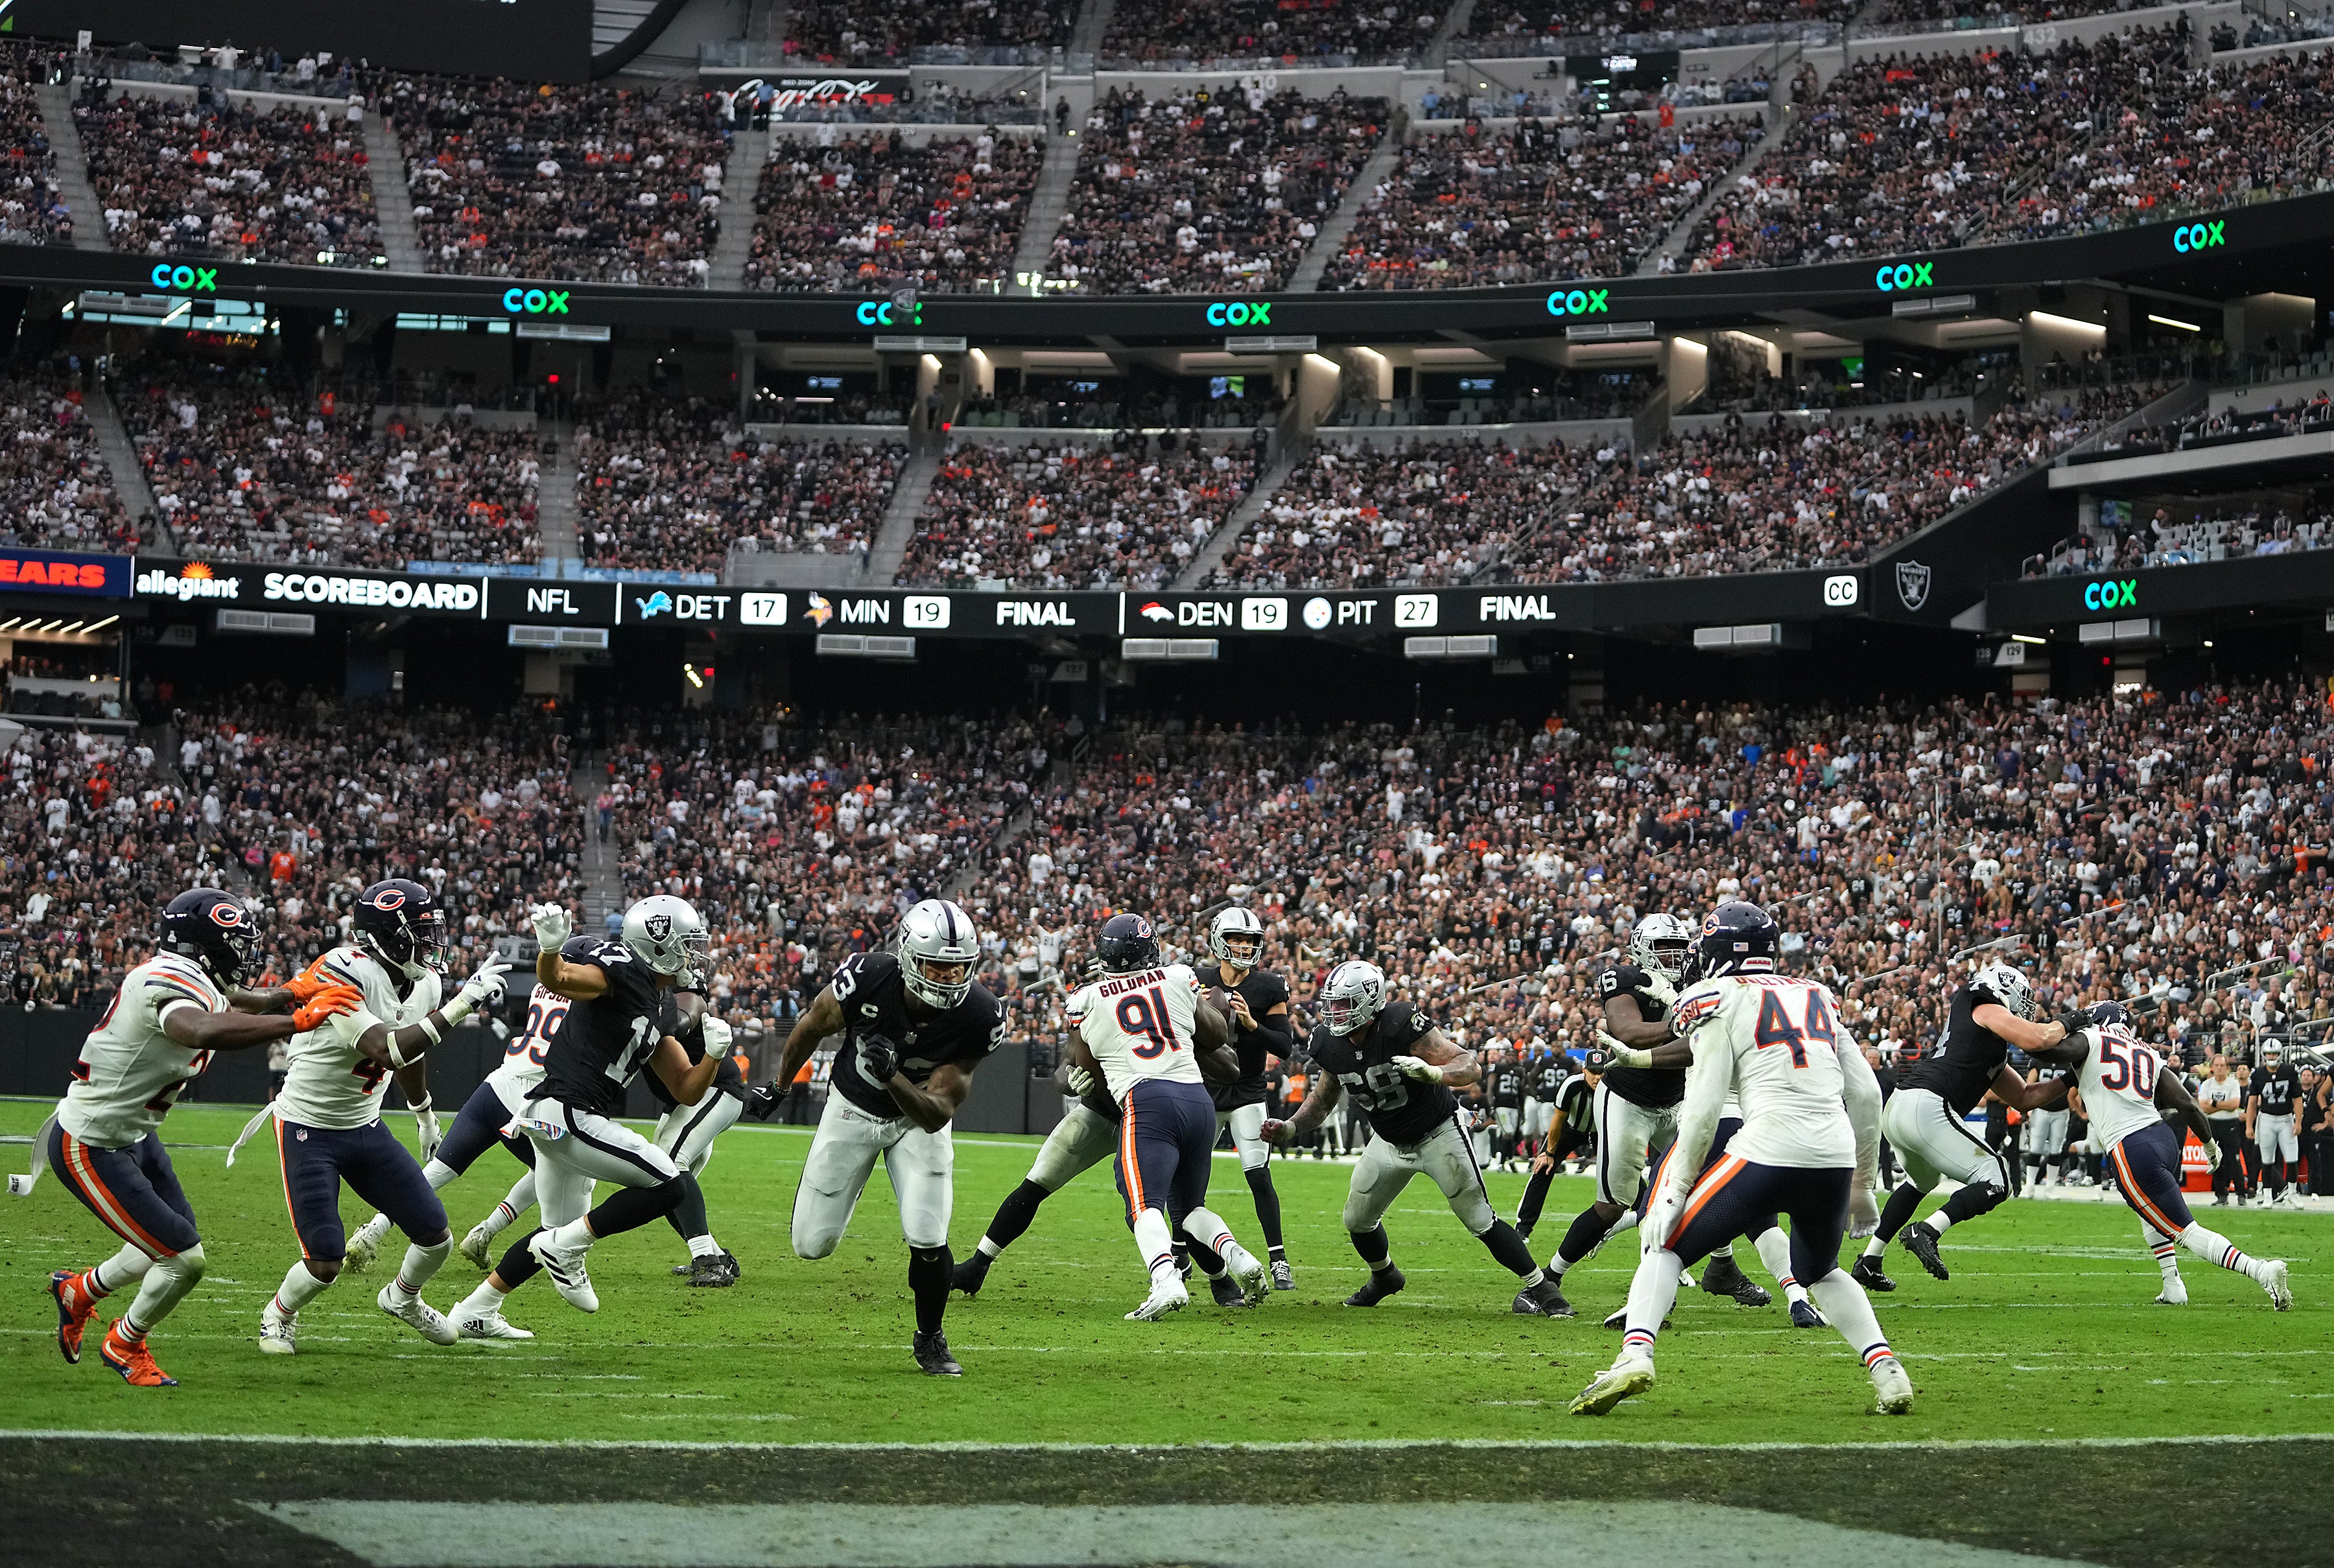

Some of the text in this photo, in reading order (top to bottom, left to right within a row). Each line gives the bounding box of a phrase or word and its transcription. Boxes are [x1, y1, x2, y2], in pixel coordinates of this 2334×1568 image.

[2173, 219, 2225, 253] COX
[151, 264, 217, 291] COX
[1876, 261, 1933, 292] COX
[502, 288, 570, 314] COX
[1206, 301, 1271, 327] COX
[1546, 288, 1609, 316] COX
[0, 559, 106, 589] EARS
[136, 570, 478, 611] allegiant SCOREBOARD
[527, 588, 579, 614] NFL
[1829, 582, 1853, 600] CC
[2084, 579, 2137, 611] COX
[676, 594, 775, 620] DET 17
[840, 599, 1076, 626] MIN 19 FINAL
[1178, 595, 1557, 626] DEN 19 PIT 27 FINAL
[2006, 645, 2022, 656] 129
[1098, 969, 1166, 998] GOLDMAN
[1115, 985, 1182, 1060] 91
[1754, 987, 1836, 1069] 44
[2100, 1035, 2155, 1100] 50
[2261, 1079, 2291, 1105] 47
[2182, 1145, 2210, 1162] ATOR
[60, 1283, 77, 1311] NIKE
[462, 1322, 487, 1337] adidas
